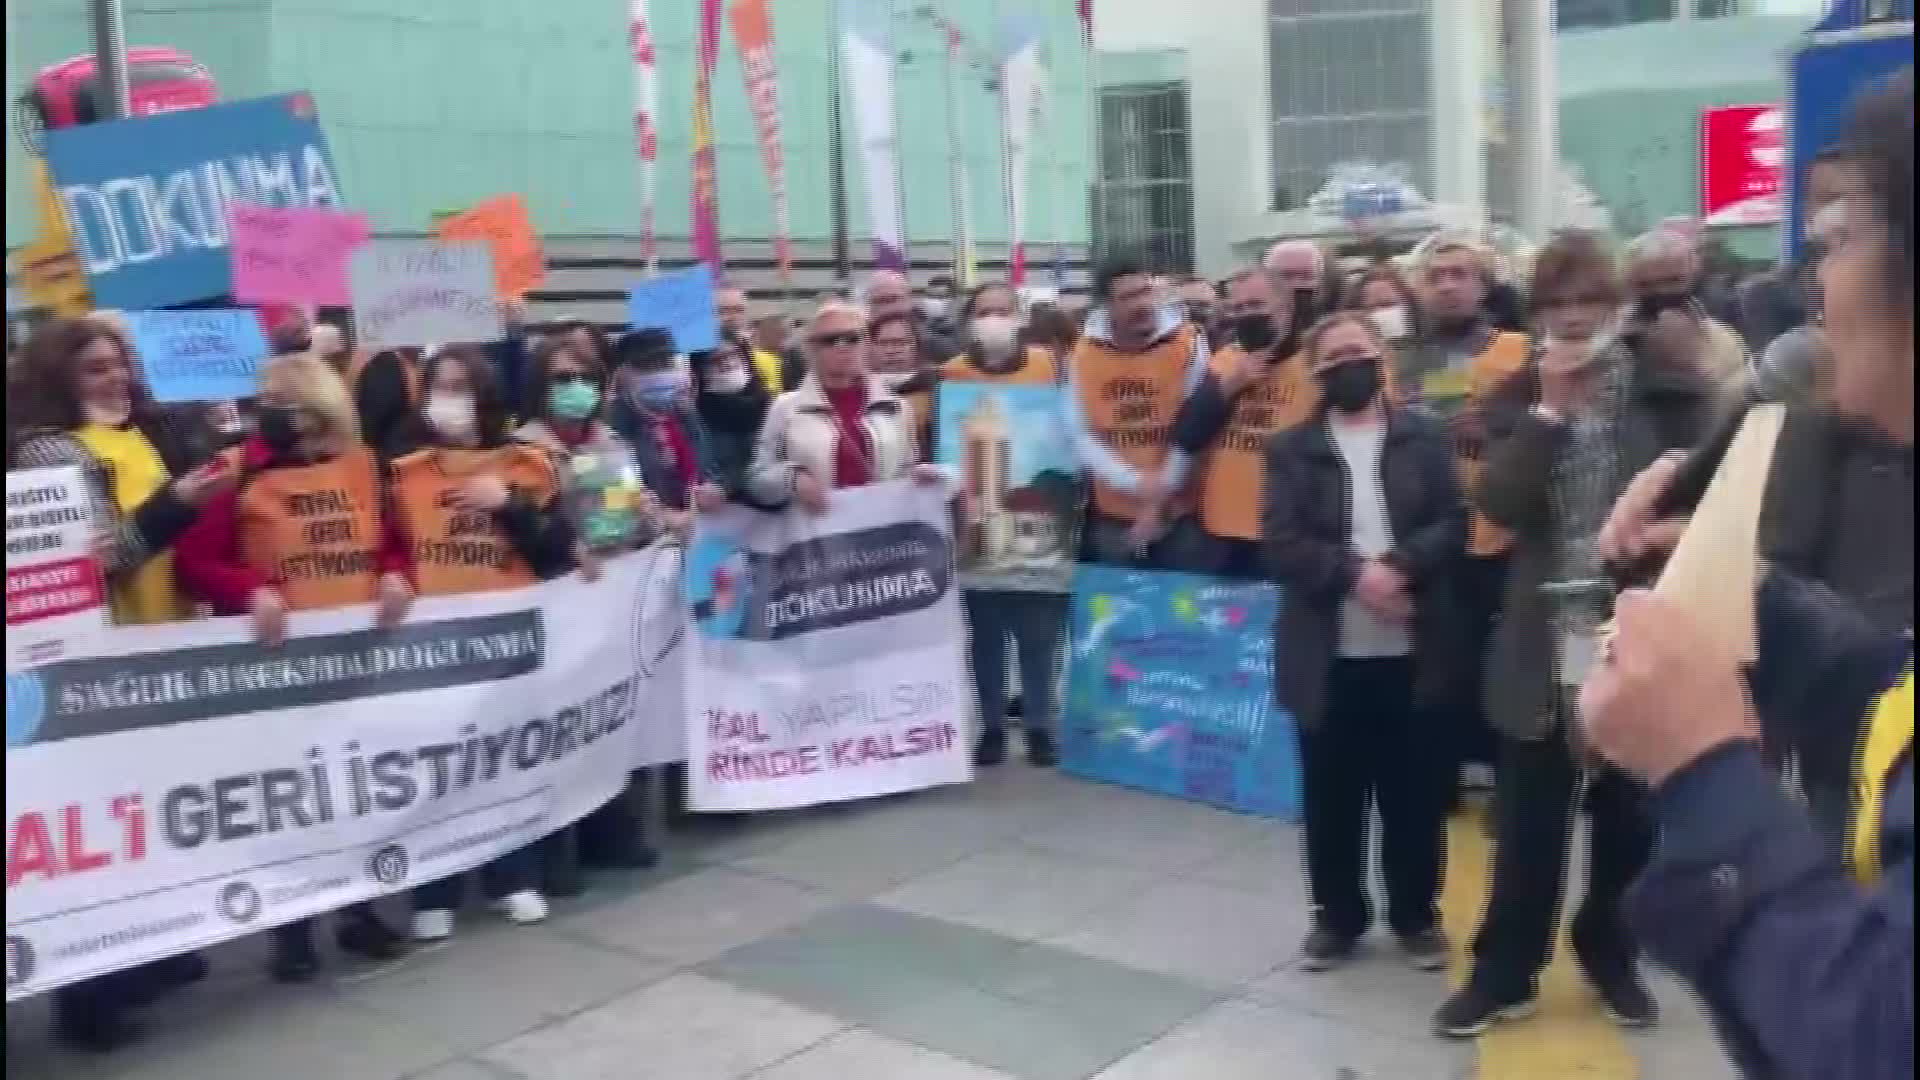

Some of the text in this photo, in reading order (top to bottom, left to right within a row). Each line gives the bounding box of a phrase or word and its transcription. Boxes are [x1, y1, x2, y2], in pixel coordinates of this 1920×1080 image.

[60, 143, 344, 274] DOKUNMA
[763, 567, 936, 628] DOKUNMA
[57, 667, 196, 717] SAĞLIK
[369, 627, 538, 673] DOKUNMA
[706, 709, 770, 743] FAL
[161, 747, 334, 849] GERİ
